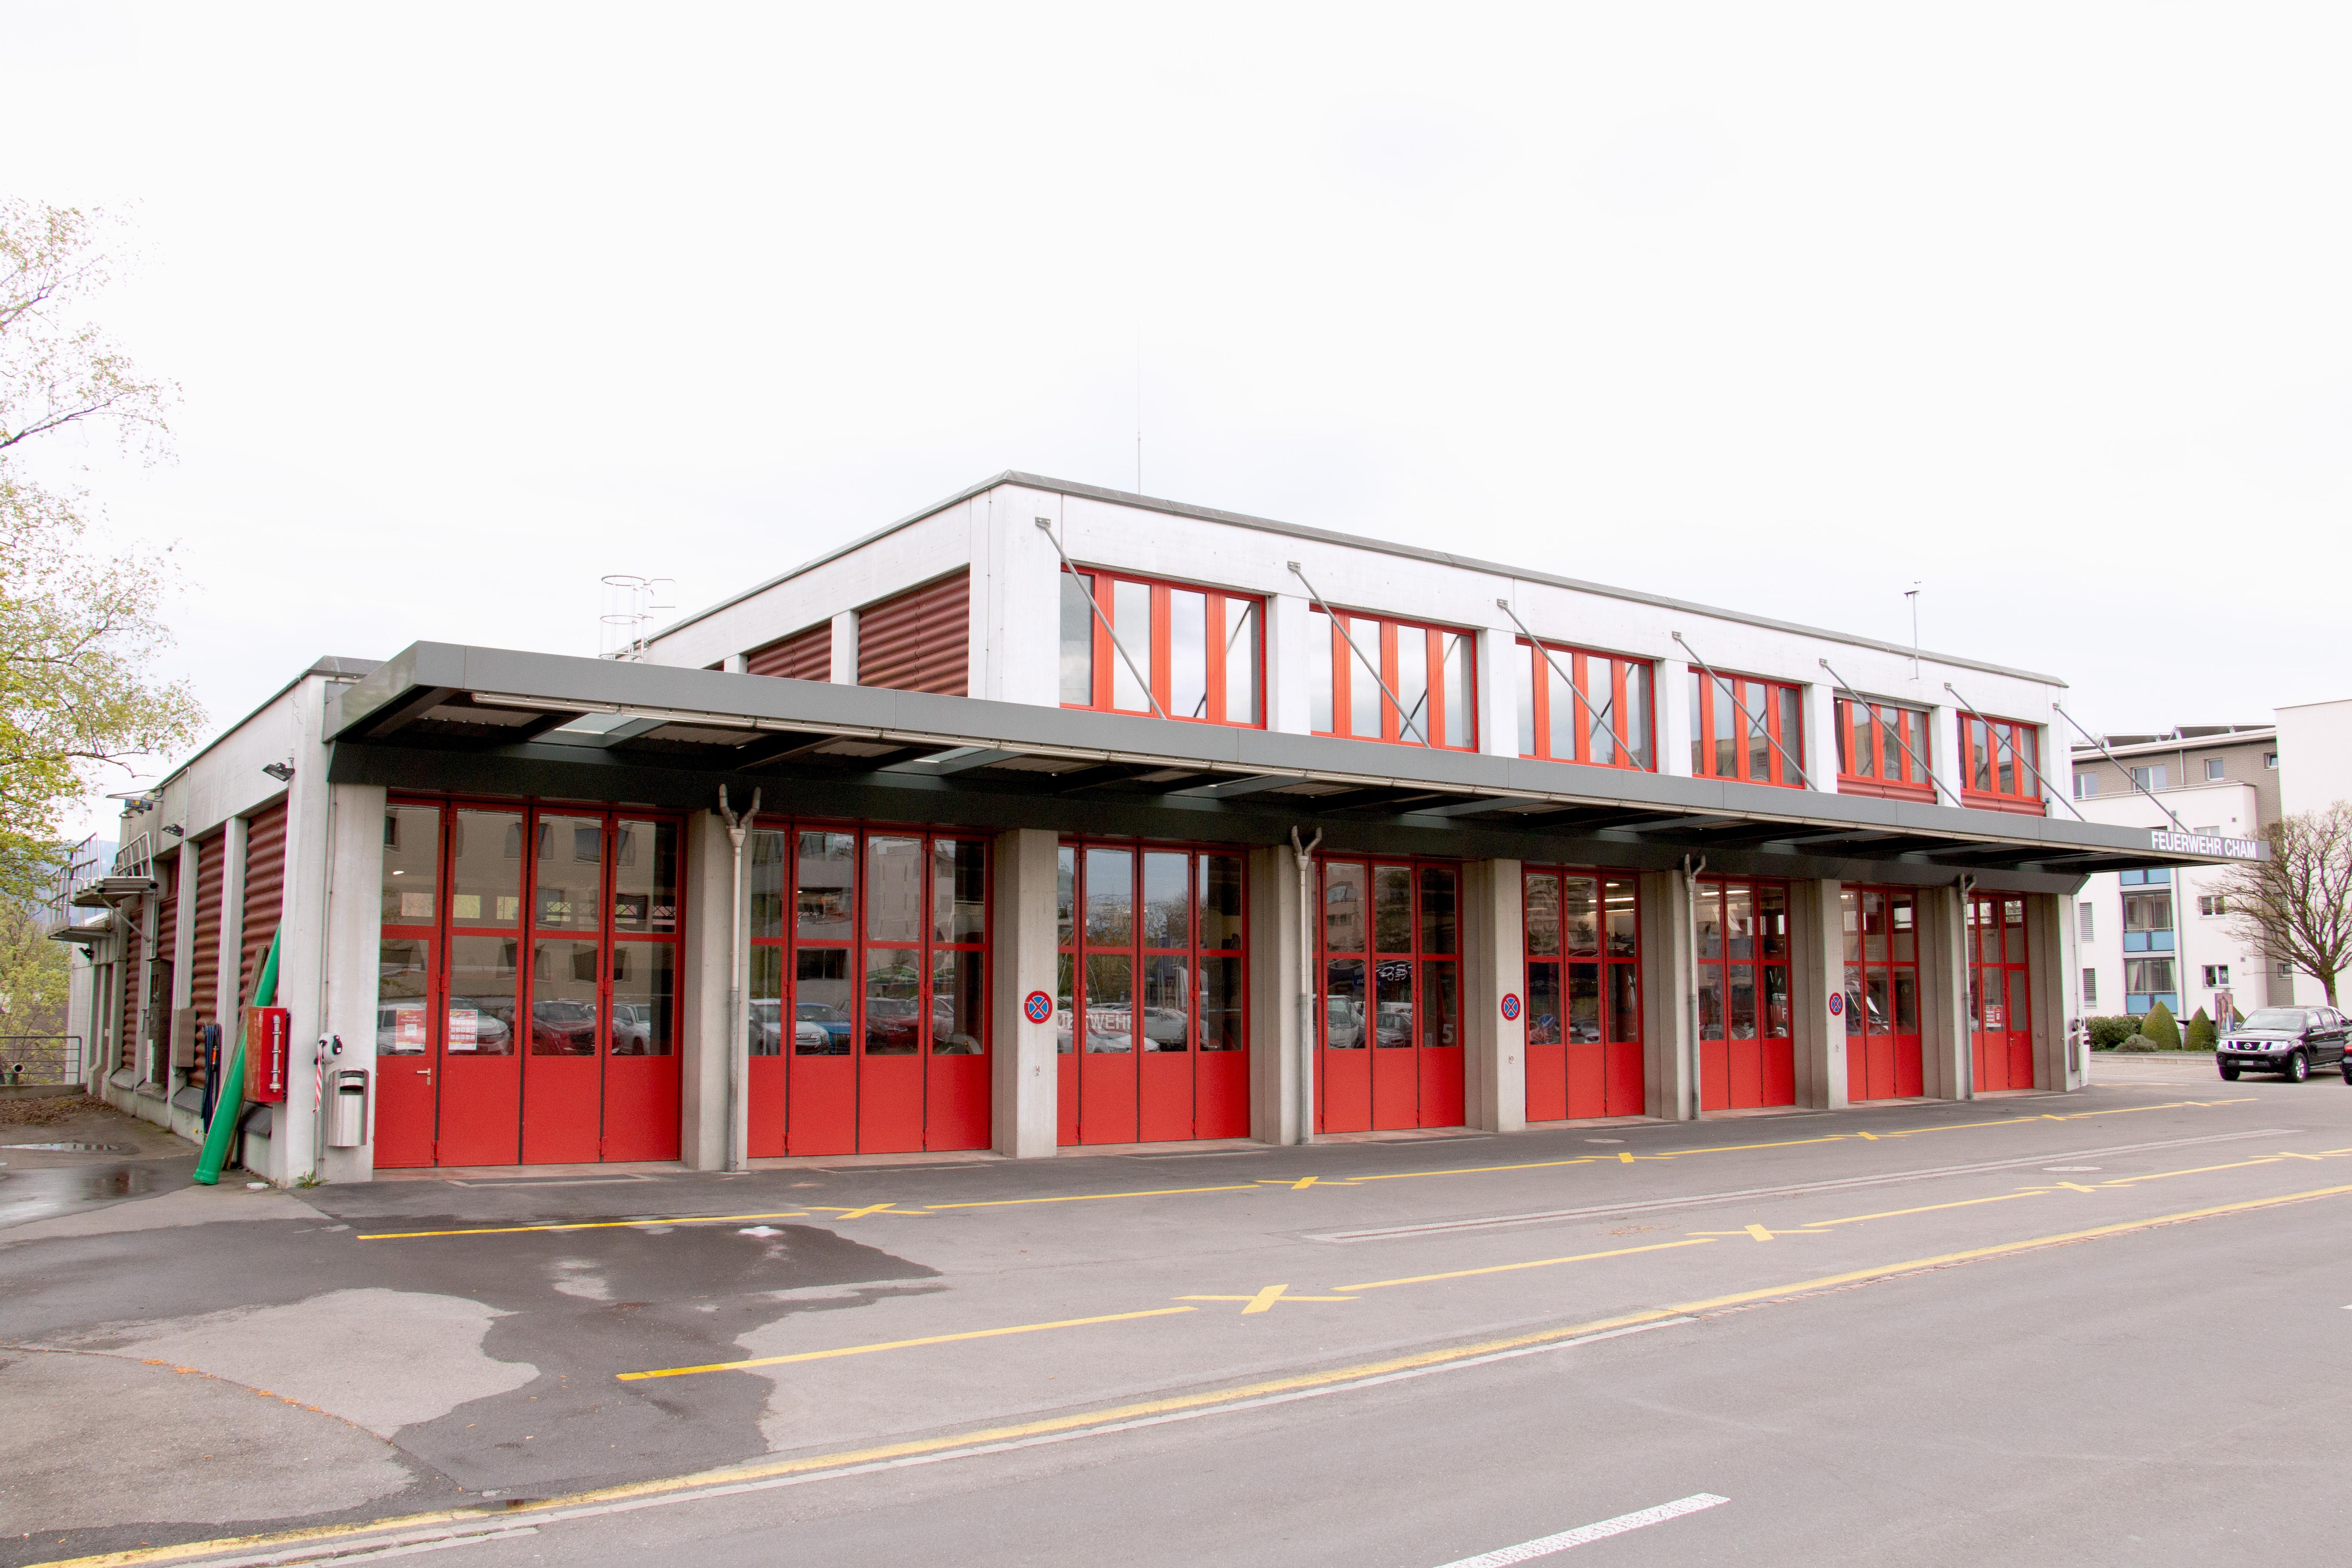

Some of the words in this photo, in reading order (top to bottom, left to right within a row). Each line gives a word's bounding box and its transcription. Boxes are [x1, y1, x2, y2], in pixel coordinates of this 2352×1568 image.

[2151, 831, 2222, 855] FEUERWEHR
[2224, 839, 2257, 858] CHAM
[1442, 1023, 1453, 1044] 5
